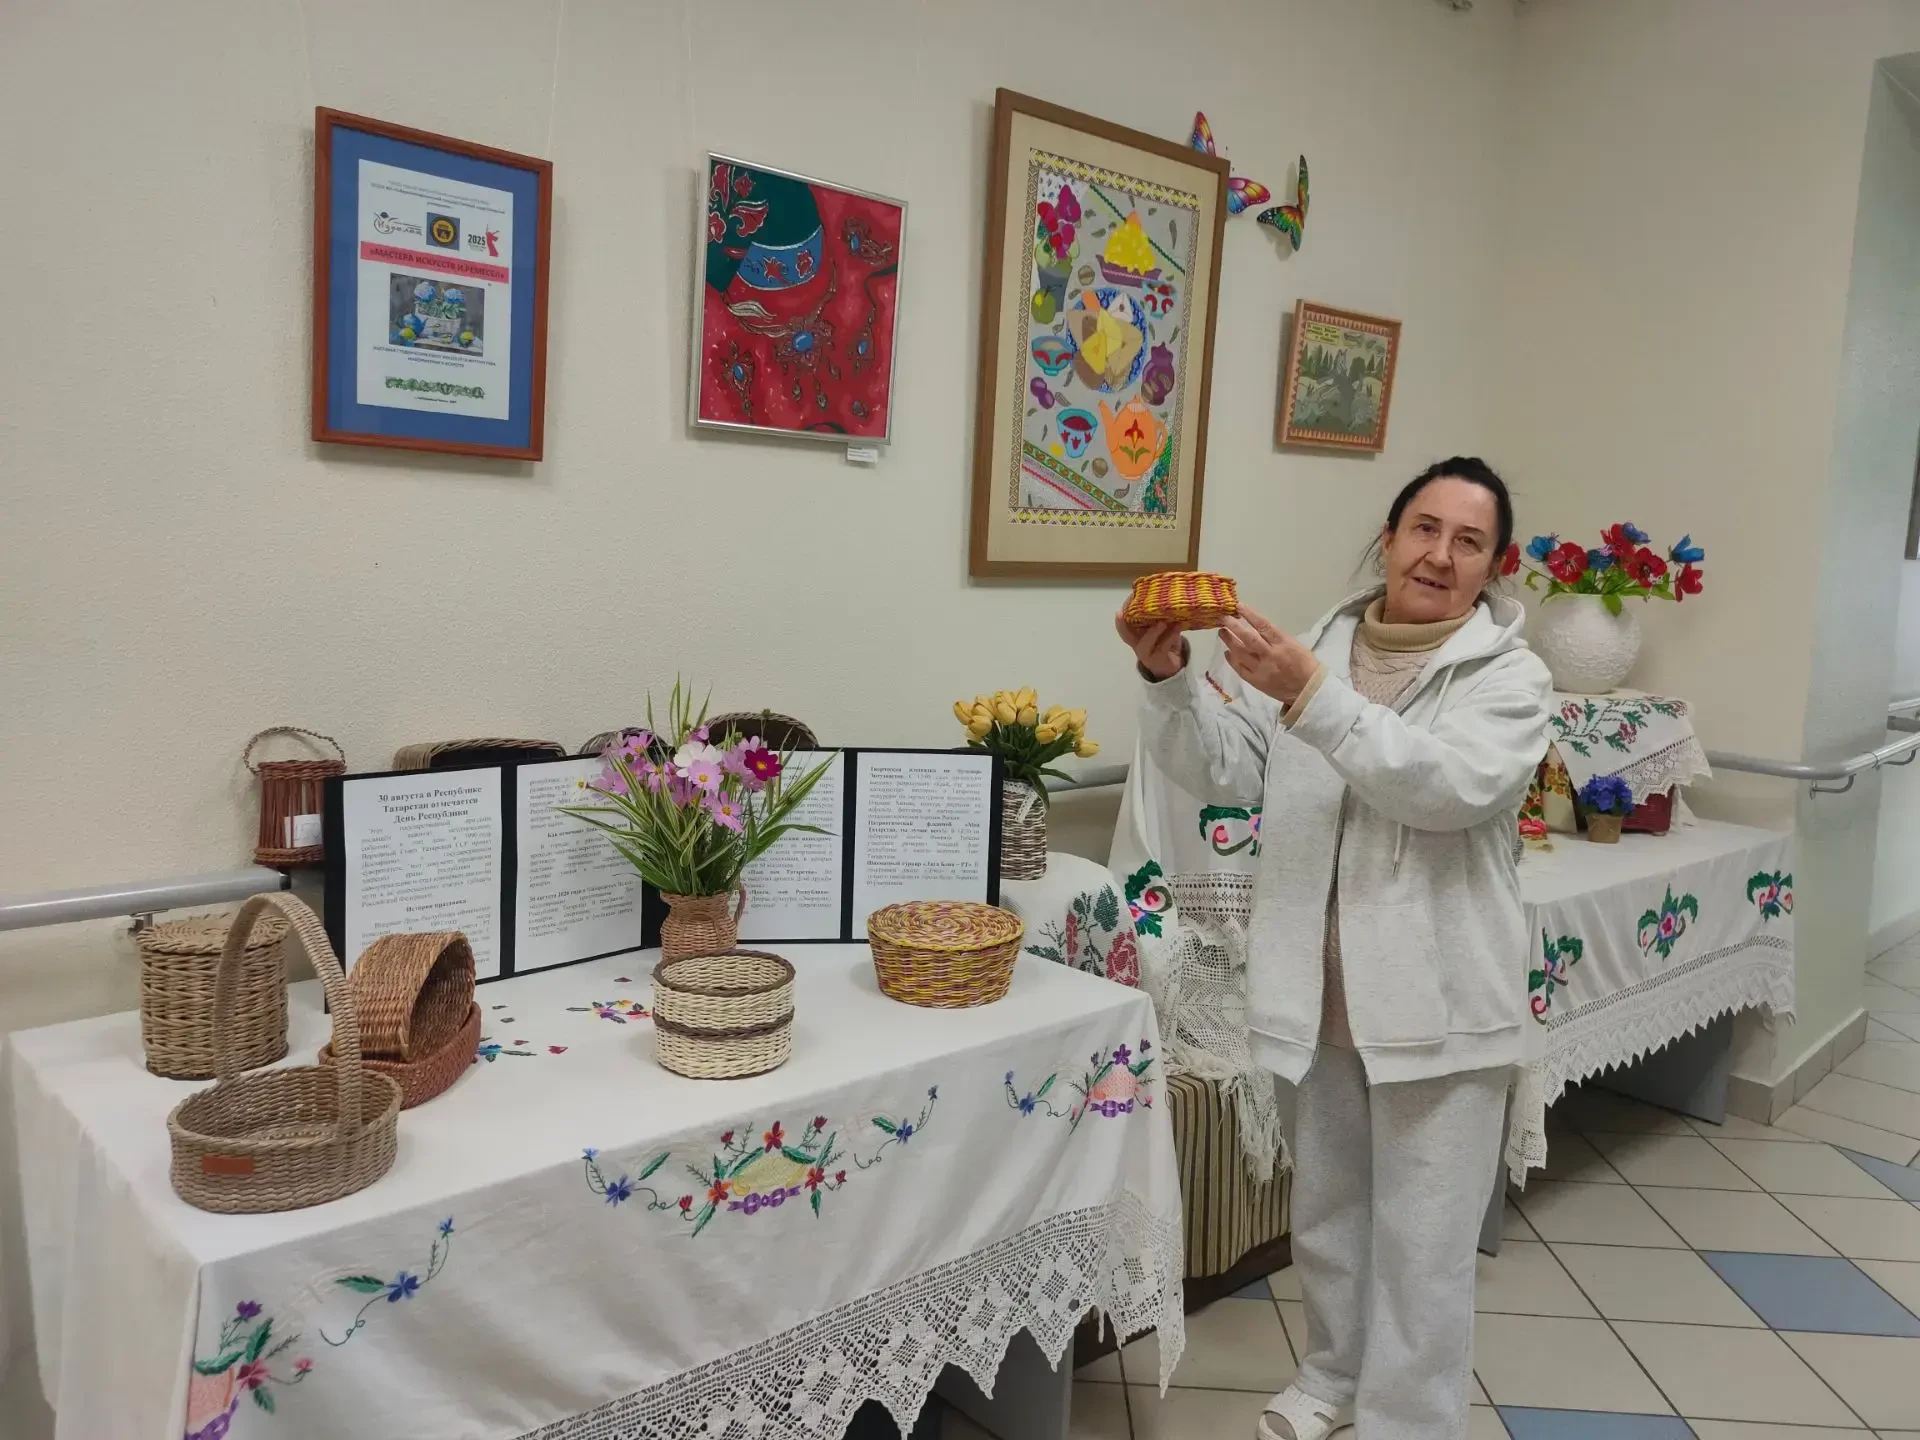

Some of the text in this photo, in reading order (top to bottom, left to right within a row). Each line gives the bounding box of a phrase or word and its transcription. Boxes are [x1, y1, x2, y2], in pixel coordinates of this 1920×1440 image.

[468, 234, 486, 246] 2025
[378, 794, 388, 802] 30
[390, 792, 424, 803] августа
[434, 786, 482, 798] Республике
[383, 798, 478, 813] Татарстан отмечается
[394, 809, 468, 824] День Республики
